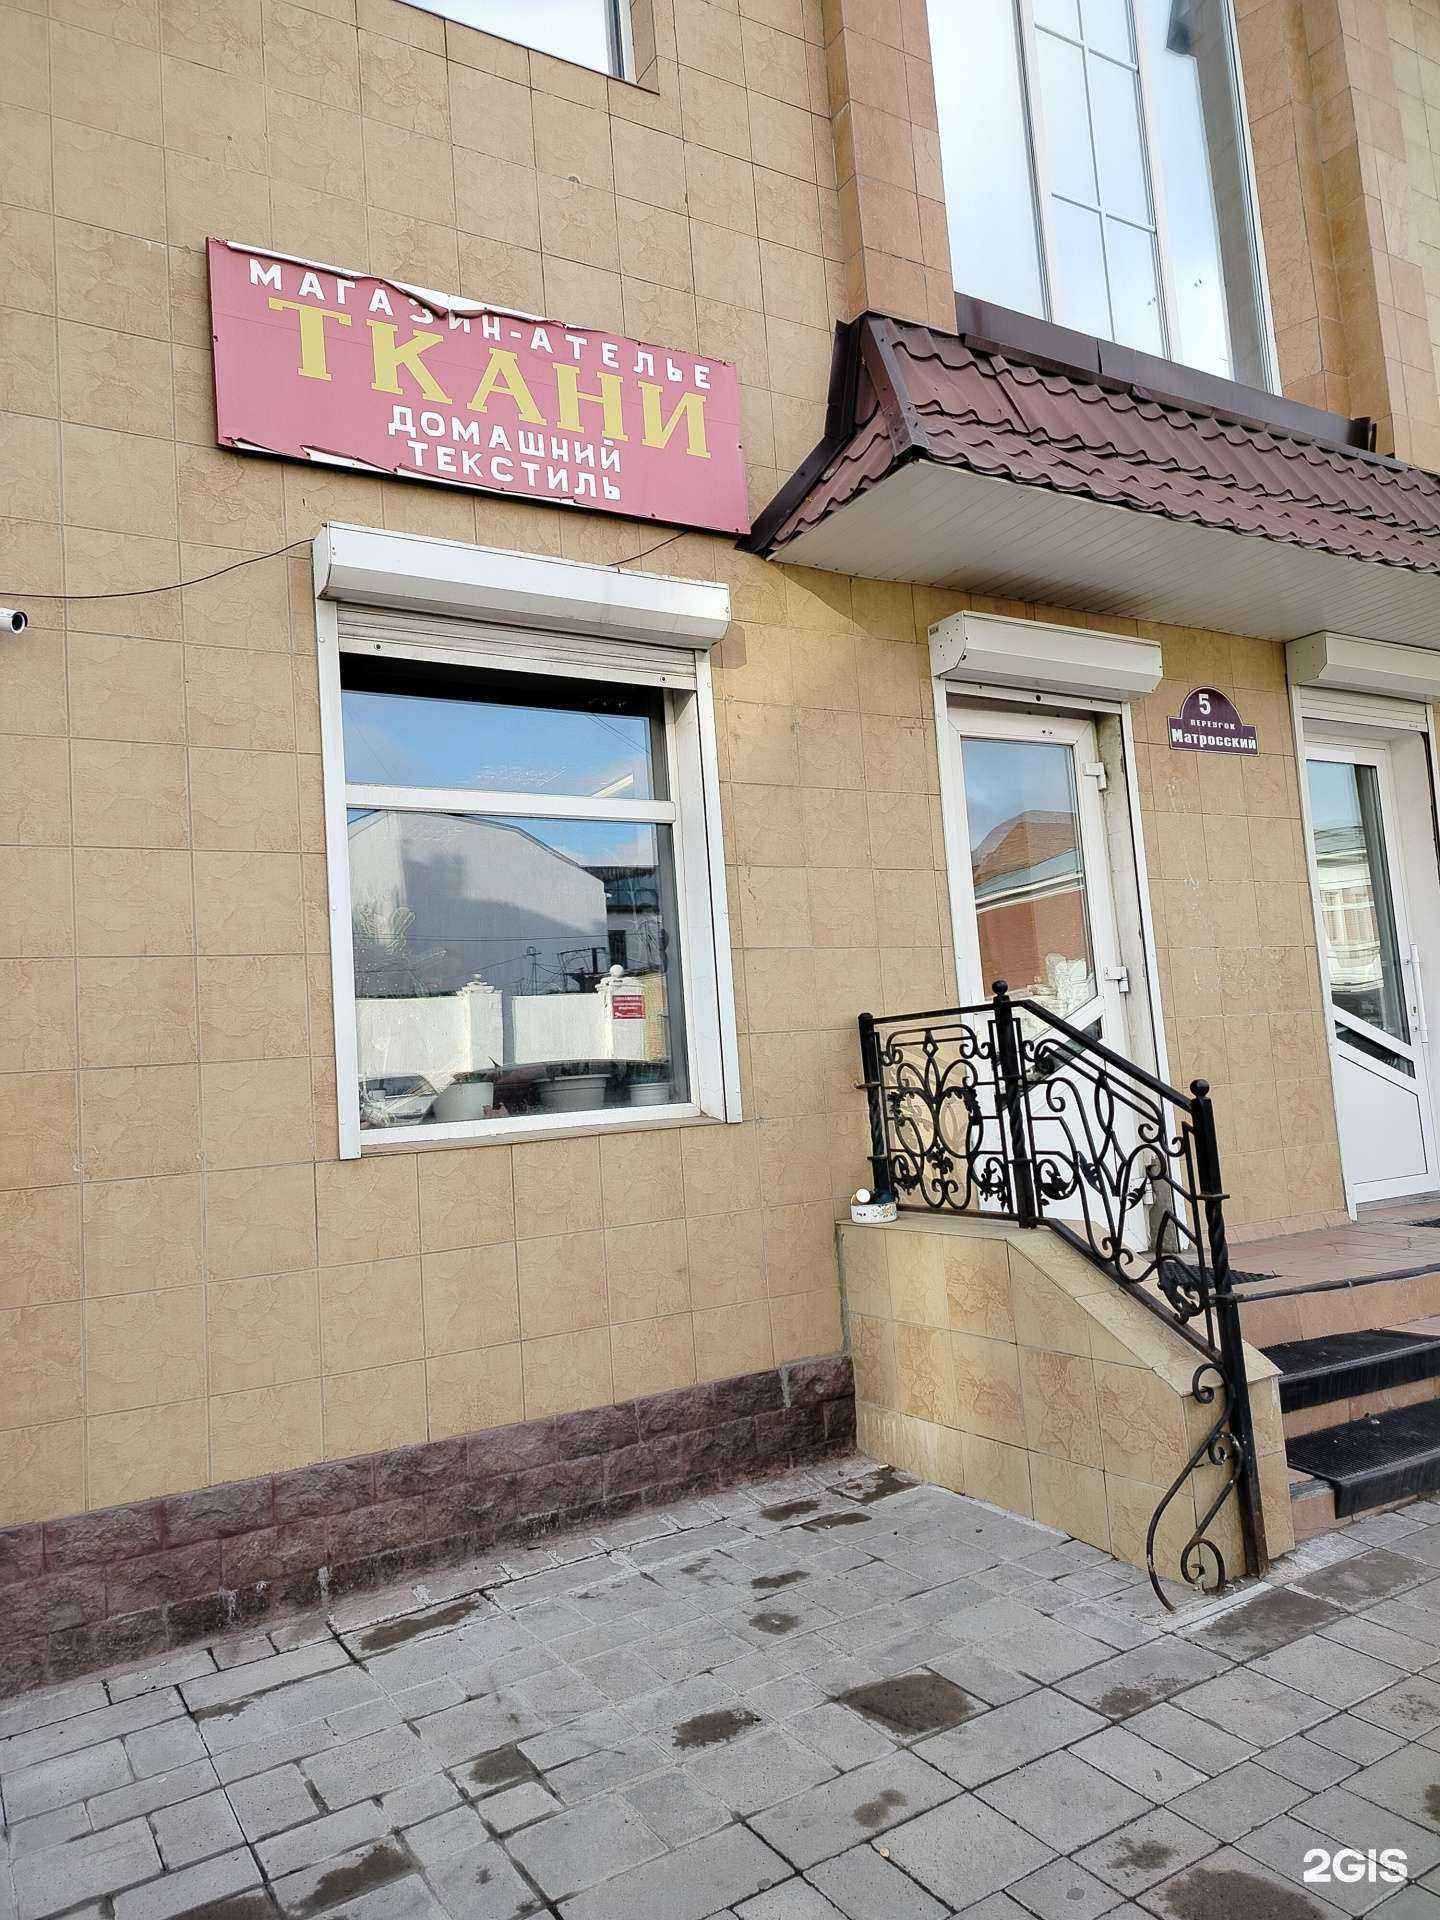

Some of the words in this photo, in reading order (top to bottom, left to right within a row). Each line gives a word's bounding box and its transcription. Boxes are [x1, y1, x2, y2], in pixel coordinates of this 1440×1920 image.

[249, 258, 712, 390] МАГАЗИН-АТЕЛЬЕ
[268, 297, 711, 459] ТКАНИ
[388, 404, 622, 473] ДОМАШНИЙ
[407, 441, 621, 501] ТЕКСТИЛЬ
[1199, 693, 1211, 715] 5
[1171, 728, 1257, 750] Матросский
